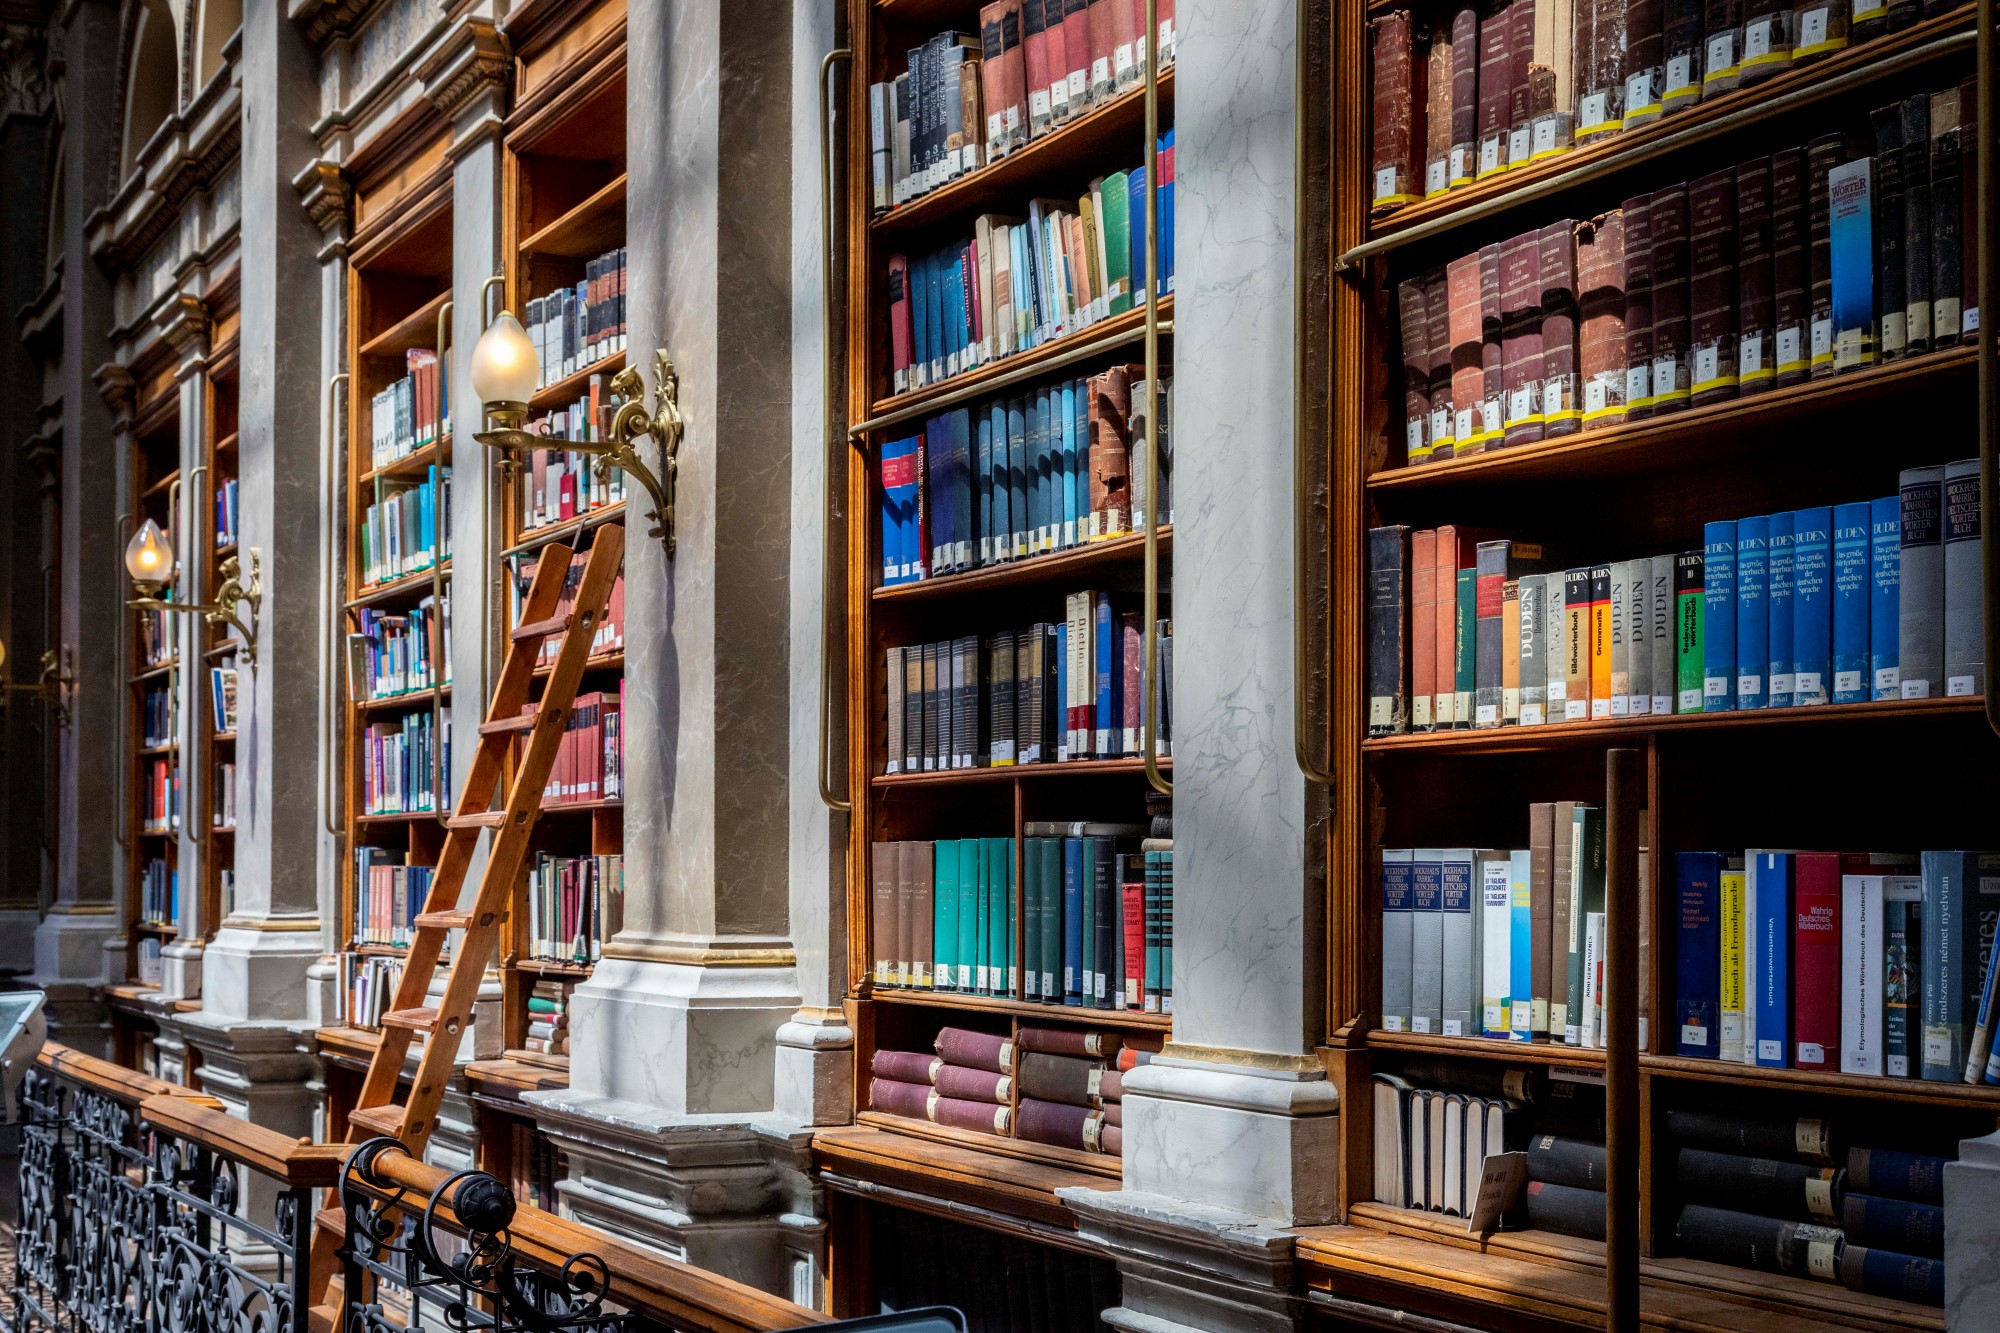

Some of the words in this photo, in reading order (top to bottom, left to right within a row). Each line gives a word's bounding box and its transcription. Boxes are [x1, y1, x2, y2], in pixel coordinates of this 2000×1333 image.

[933, 144, 938, 154] 3
[912, 155, 917, 163] 1
[925, 150, 930, 160] 2
[1832, 178, 1866, 198] WÖRTER
[1901, 488, 1938, 502] BROCKHAUS
[1952, 491, 1975, 503] WAHRIG
[1905, 501, 1930, 510] WAHRIG
[1901, 510, 1937, 521] DEUTSCHES
[1954, 522, 1971, 533] BUCH
[1796, 530, 1826, 544] DUDEN
[1834, 527, 1866, 539] DUDEN
[1908, 529, 1925, 539] BUCH
[1738, 538, 1766, 550] DUDEN
[1845, 550, 1863, 558] große
[1679, 556, 1703, 566] DUDEN
[1566, 571, 1588, 582] DUDEN
[1592, 569, 1611, 579] DUDEN
[1687, 570, 1694, 578] 10
[1836, 574, 1862, 583] deutschen
[1598, 582, 1602, 591] 4
[1797, 578, 1823, 586] deutschen
[1838, 582, 1859, 591] Sprache
[1573, 586, 1577, 594] 3
[1799, 586, 1820, 594] Sprache
[1706, 595, 1727, 603] Sprache
[1534, 585, 1543, 634] Rechtschreibung
[1633, 581, 1643, 642] DUDEN
[1655, 576, 1666, 638] DUDEN
[1613, 583, 1622, 644] DUDEN
[1522, 588, 1533, 659] DUDEN
[1941, 876, 1950, 922] nyelvtan
[1731, 880, 1740, 950] Fremdsprache
[1811, 906, 1833, 916] Wahrig
[1799, 914, 1830, 923] Deutsches
[1799, 922, 1833, 930] Wörterbuch
[1939, 966, 1948, 1028] Rendszeres
